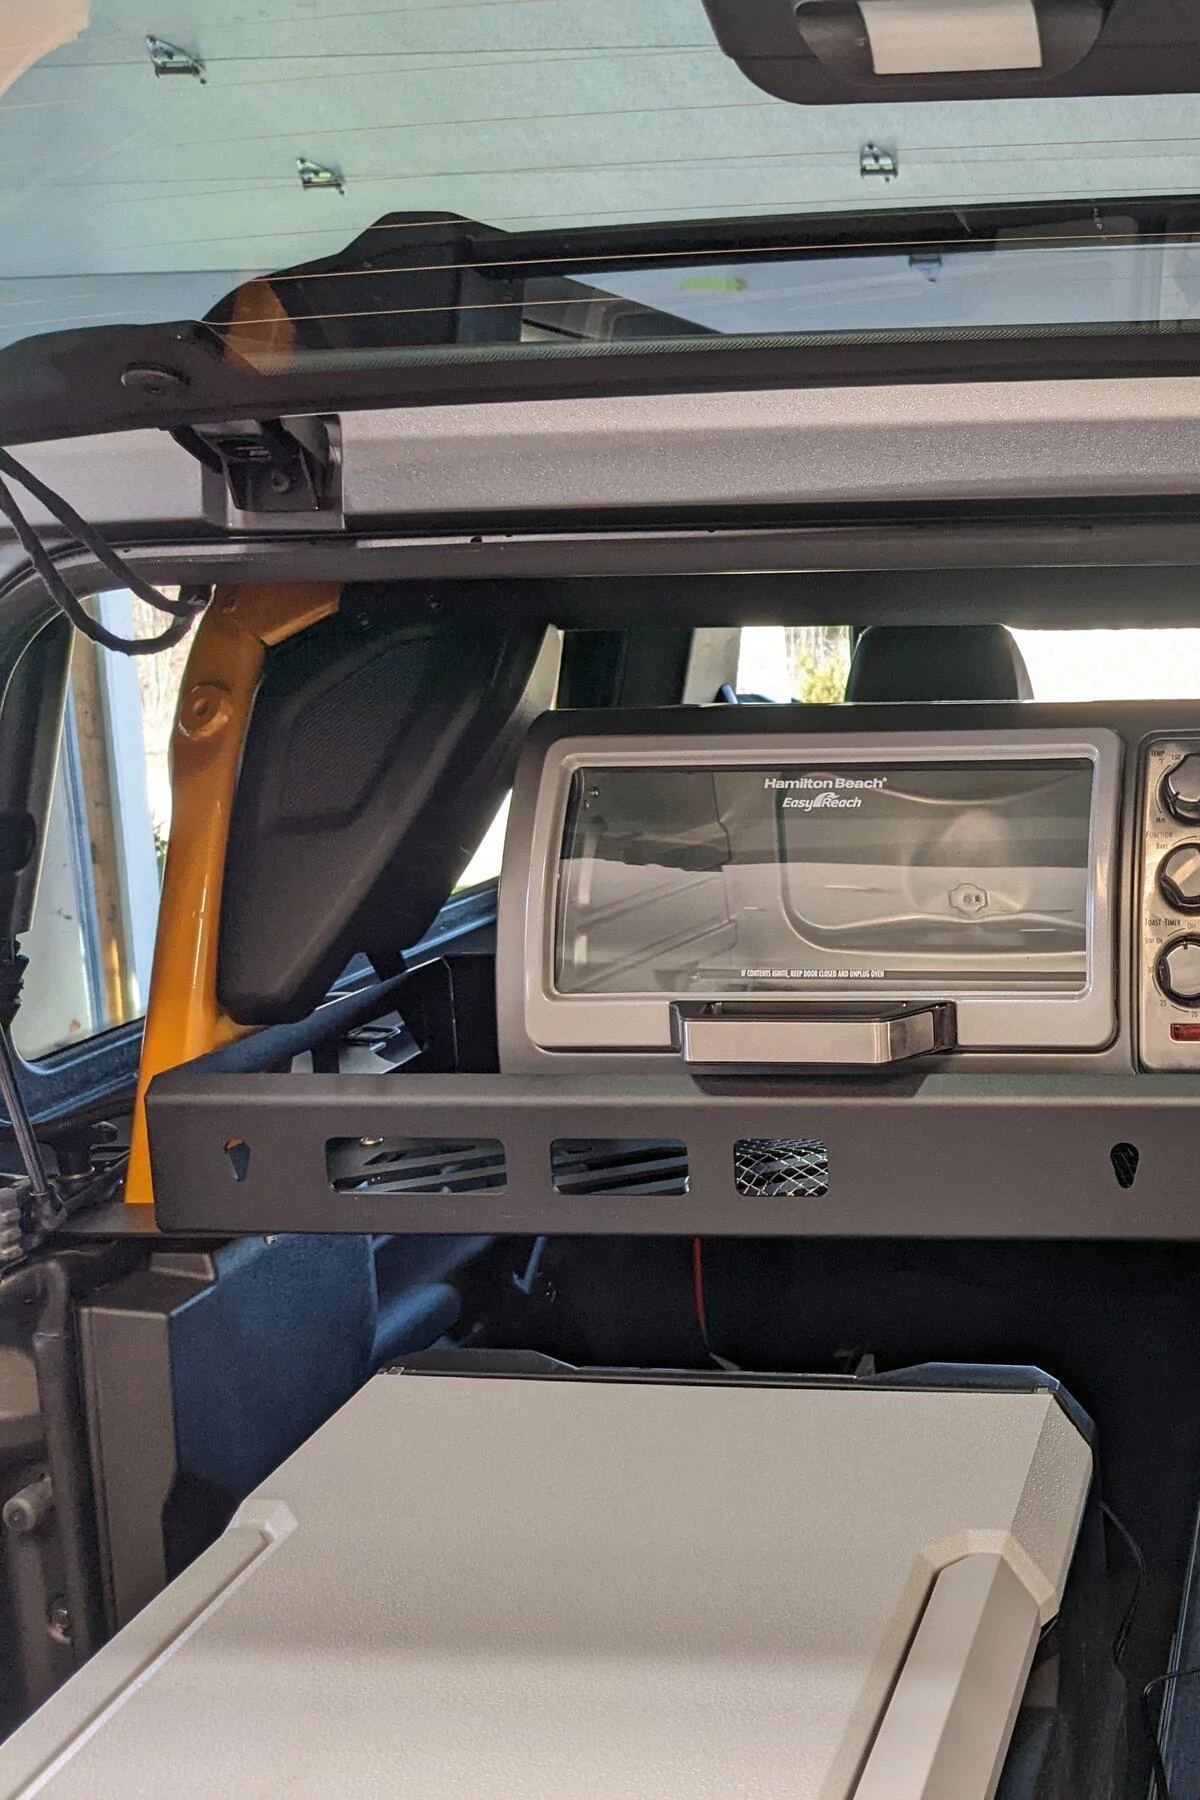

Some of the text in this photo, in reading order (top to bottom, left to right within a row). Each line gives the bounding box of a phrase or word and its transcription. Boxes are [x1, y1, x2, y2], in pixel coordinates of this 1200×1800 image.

[764, 777, 833, 789] Hamilton
[747, 969, 771, 978] CONTENTS
[790, 969, 803, 978] KEEP
[803, 969, 818, 978] DOOR
[818, 969, 837, 978] CLOSED
[837, 969, 849, 978] AND
[849, 969, 870, 978] UNPLUG
[870, 969, 885, 978] OVEN
[1160, 999, 1167, 1007] 25
